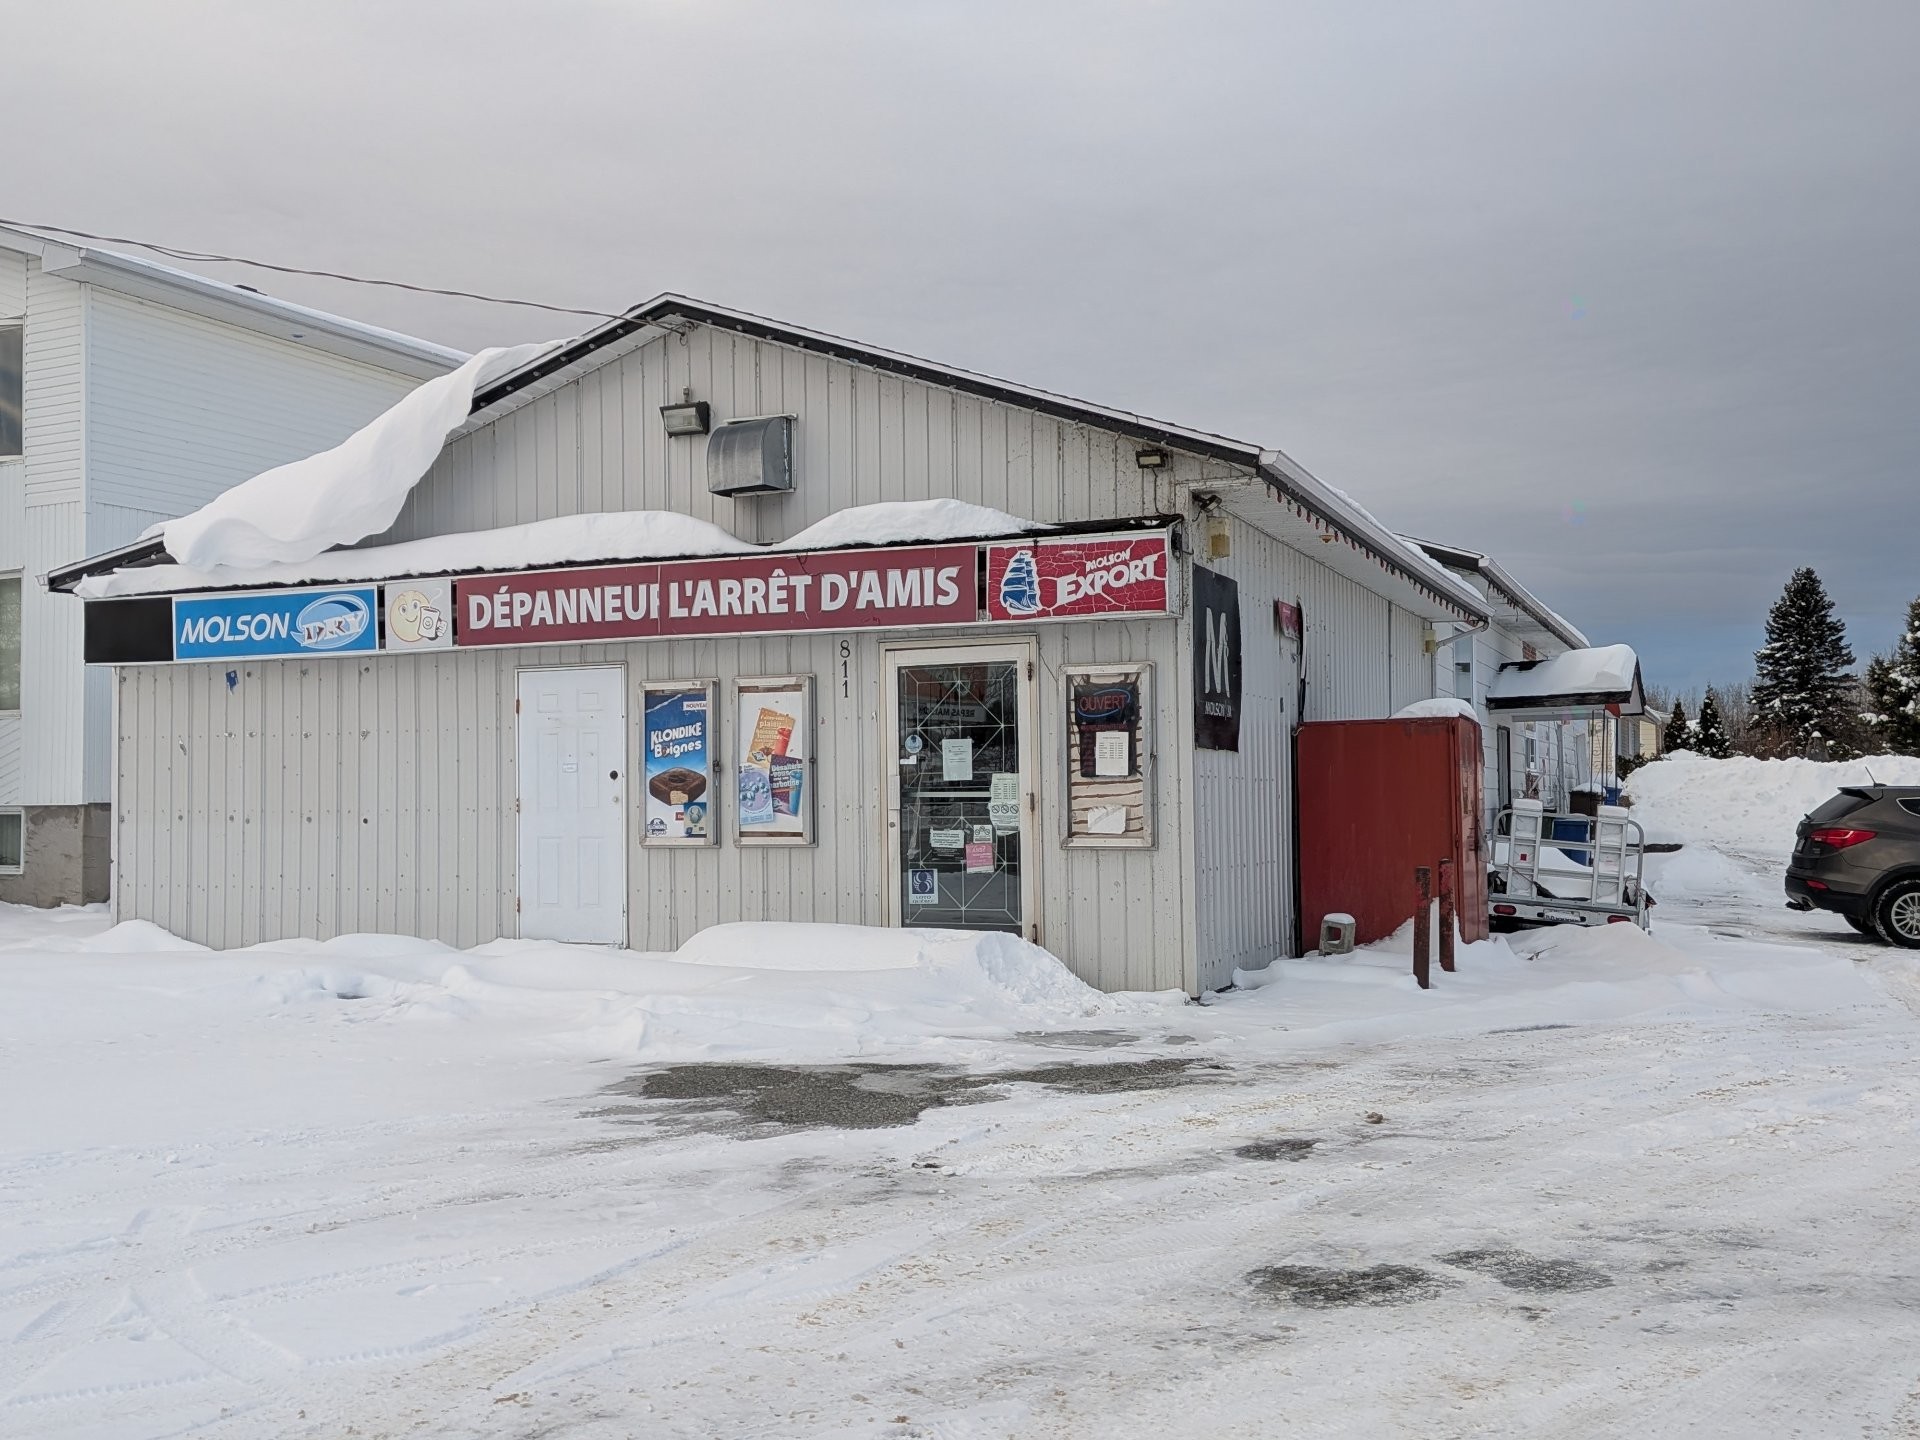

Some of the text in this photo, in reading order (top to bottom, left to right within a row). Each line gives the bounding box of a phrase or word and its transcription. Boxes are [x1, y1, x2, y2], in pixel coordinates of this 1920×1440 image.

[1086, 548, 1131, 574] MOLSON
[668, 568, 813, 618] L'ARRÊT
[820, 565, 962, 612] D'AMIS
[1056, 554, 1159, 606] EXPORT
[180, 612, 290, 644] MOLSON
[1080, 694, 1127, 711] OUVERT
[651, 722, 702, 751] KLONDIKE
